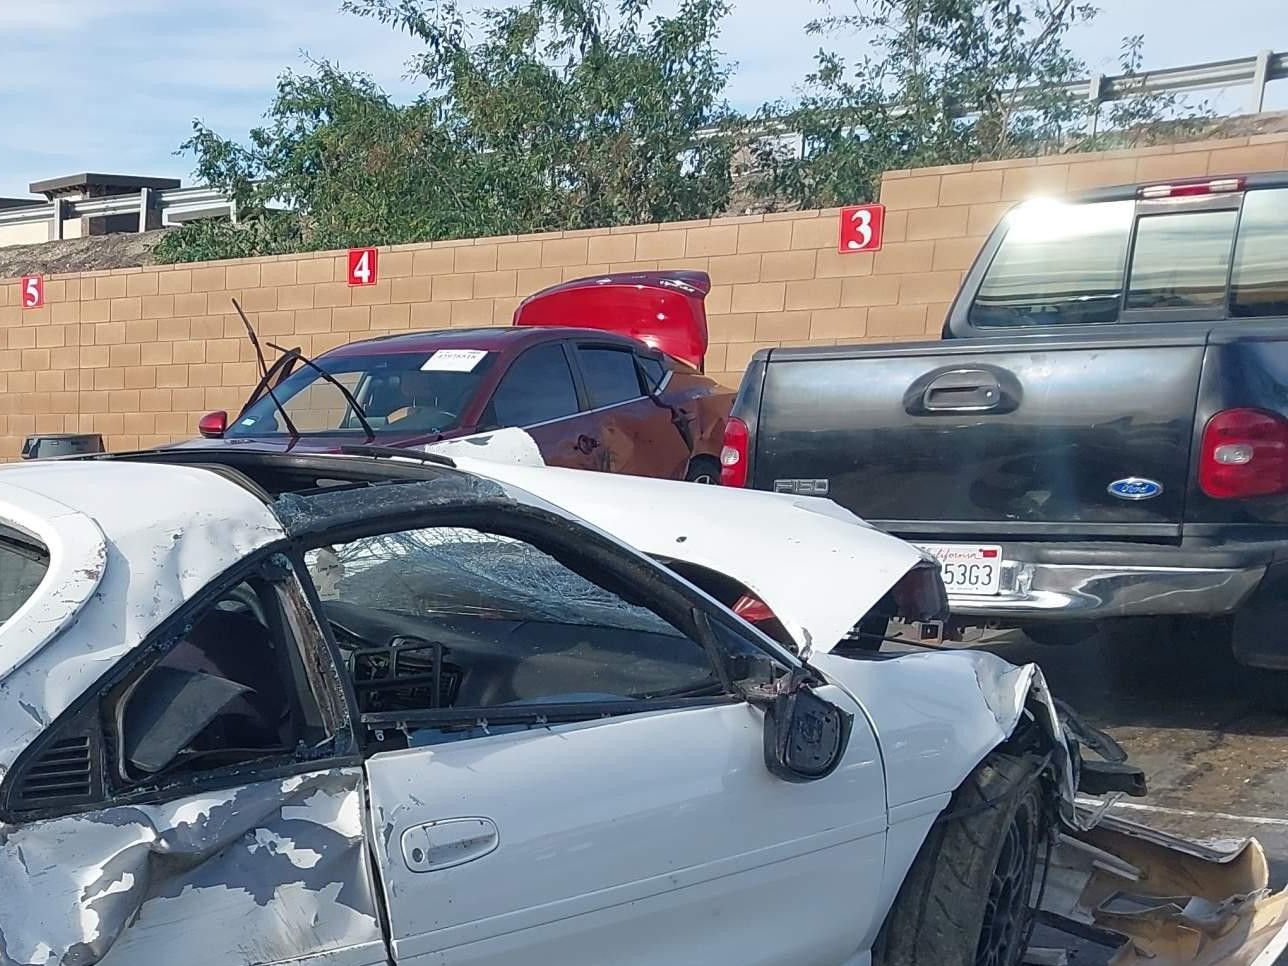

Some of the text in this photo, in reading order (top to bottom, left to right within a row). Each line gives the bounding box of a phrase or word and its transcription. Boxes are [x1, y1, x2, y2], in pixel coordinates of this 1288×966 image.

[848, 210, 872, 249] 3
[353, 251, 371, 283] 4
[26, 278, 39, 306] 5
[930, 547, 981, 561] lifornia
[944, 563, 993, 585] 53G3
